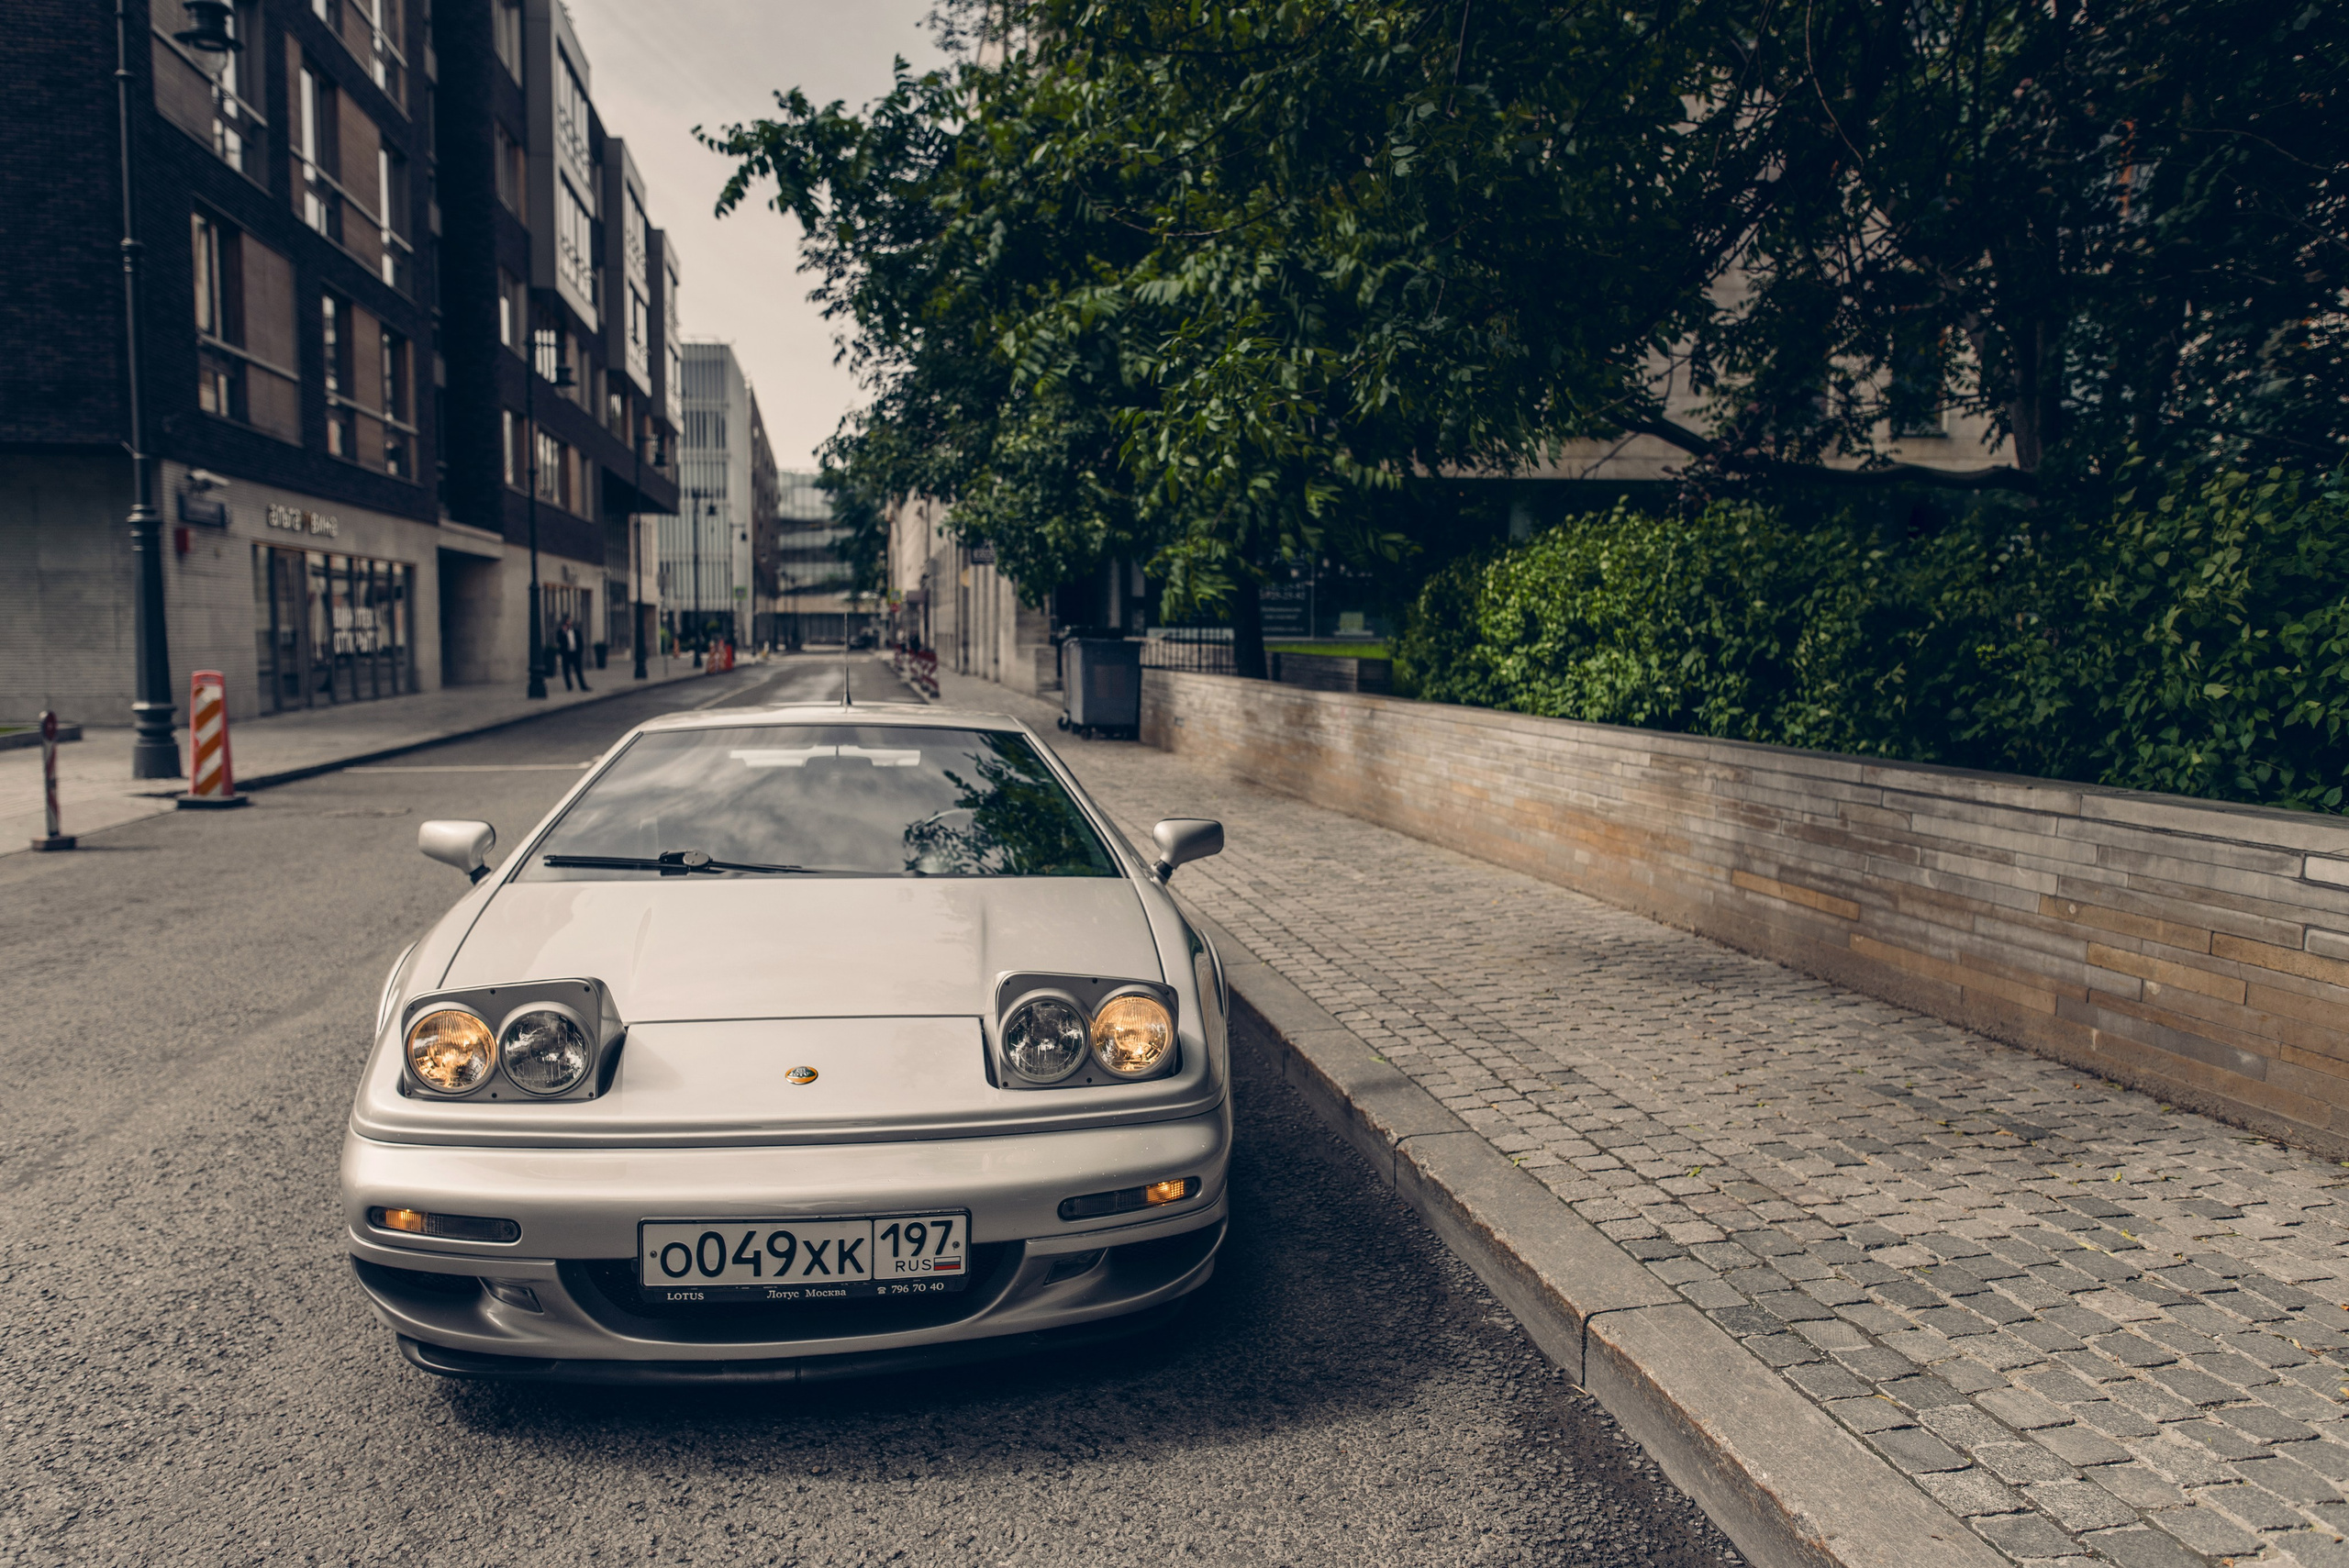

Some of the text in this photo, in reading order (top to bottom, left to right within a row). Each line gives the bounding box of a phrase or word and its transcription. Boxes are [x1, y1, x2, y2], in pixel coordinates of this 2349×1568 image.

[880, 1219, 953, 1258] 197
[895, 1259, 932, 1273] RUS
[766, 1288, 847, 1299] Лотус Москва
[891, 1283, 944, 1294] 796 70 40
[667, 1292, 705, 1301] LOTUS
